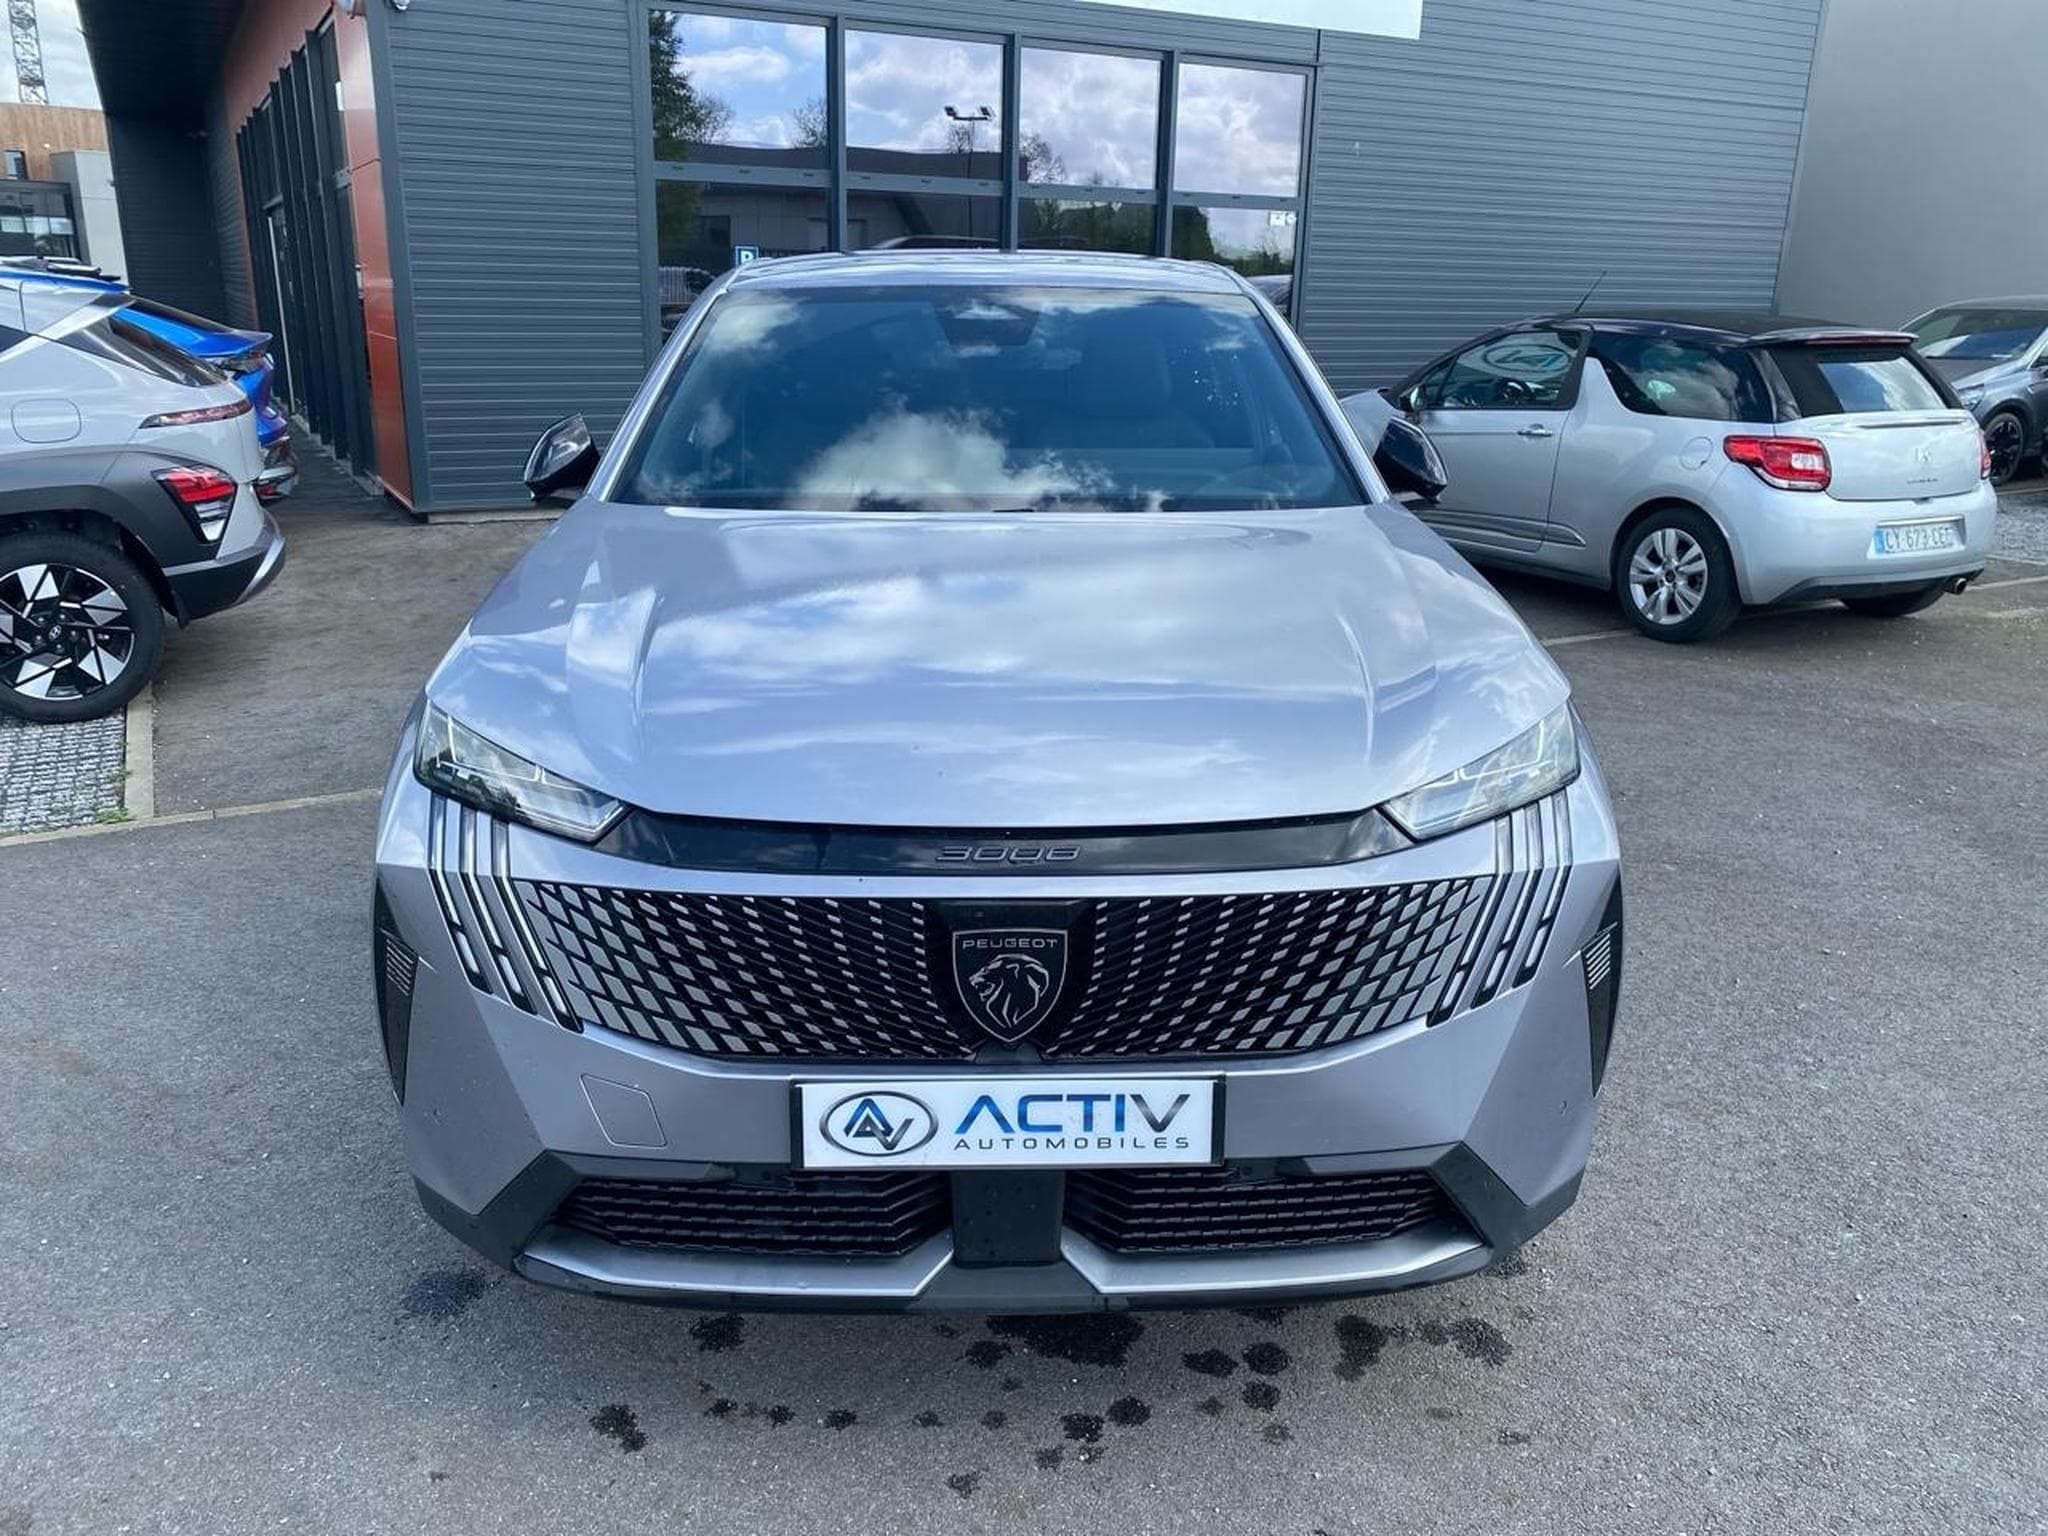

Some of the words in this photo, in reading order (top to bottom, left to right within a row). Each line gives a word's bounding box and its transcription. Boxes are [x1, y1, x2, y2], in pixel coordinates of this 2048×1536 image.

[936, 846, 1081, 861] 3008
[962, 938, 1058, 949] PEUGEOT
[954, 1094, 1191, 1134] ACTIV
[954, 1137, 1190, 1150] AUTOMOBILES
